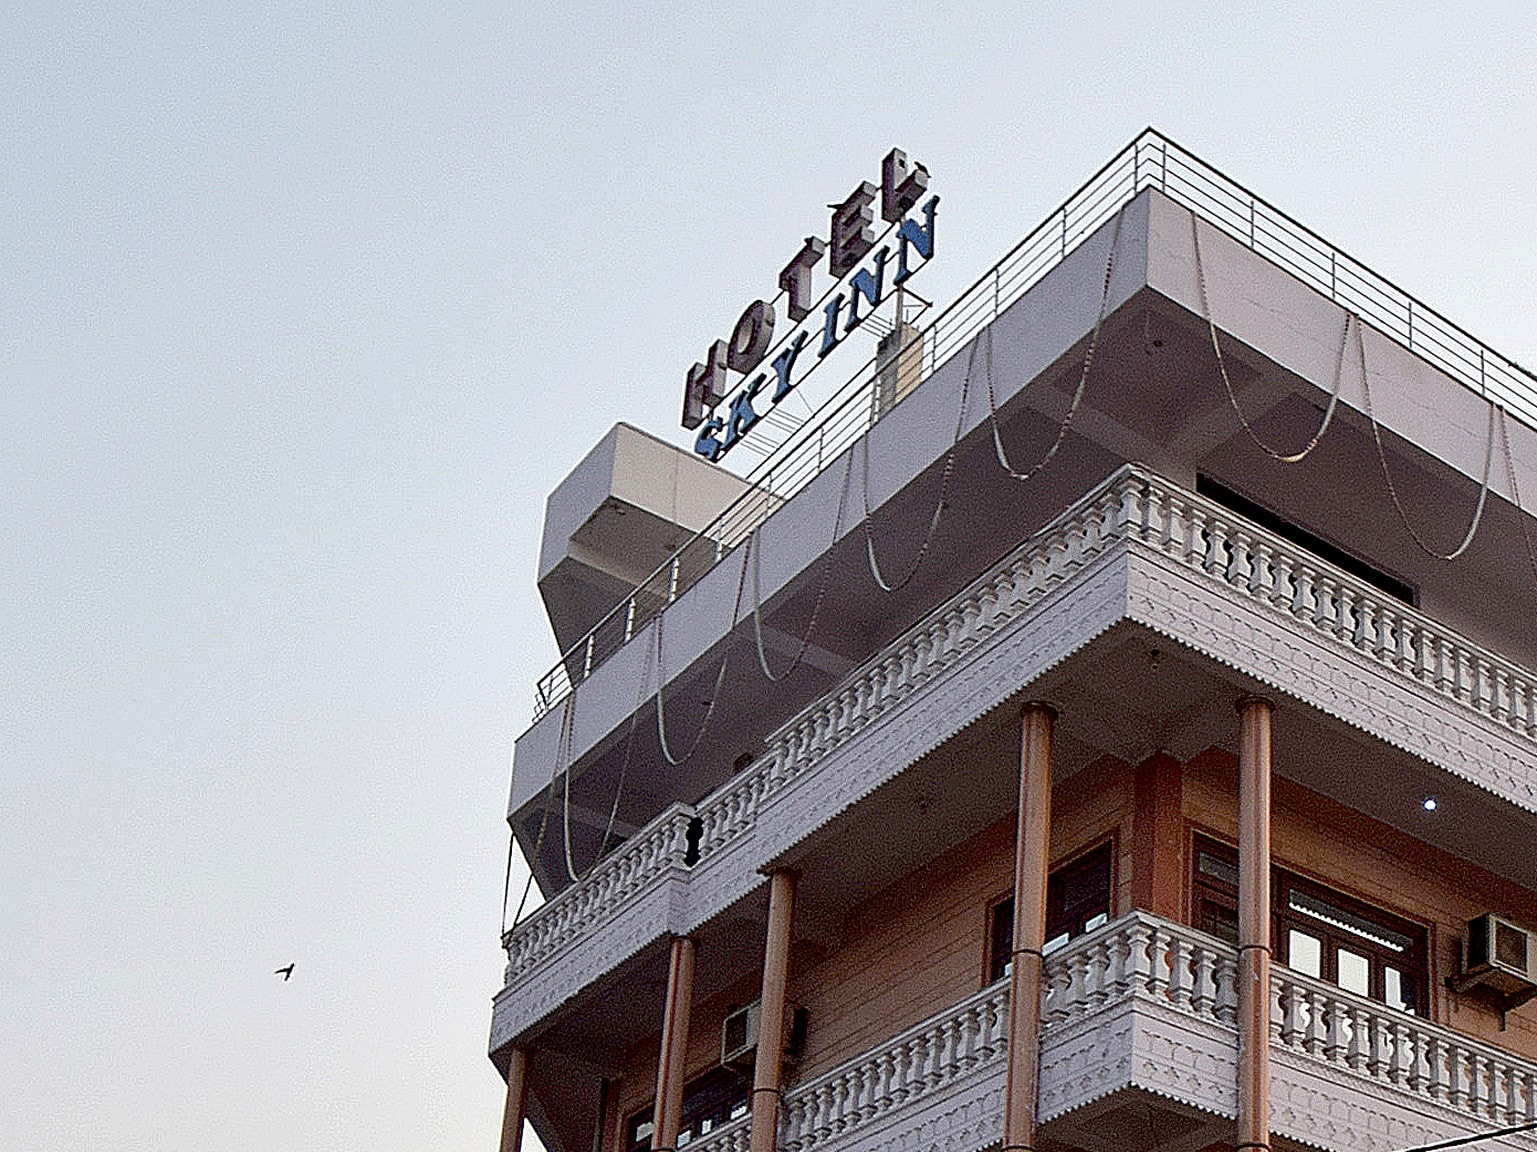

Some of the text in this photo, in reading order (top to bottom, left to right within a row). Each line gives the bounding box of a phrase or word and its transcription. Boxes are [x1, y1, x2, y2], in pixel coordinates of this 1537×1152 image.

[681, 147, 928, 430] HOTEL
[695, 195, 941, 462] SKY INN
